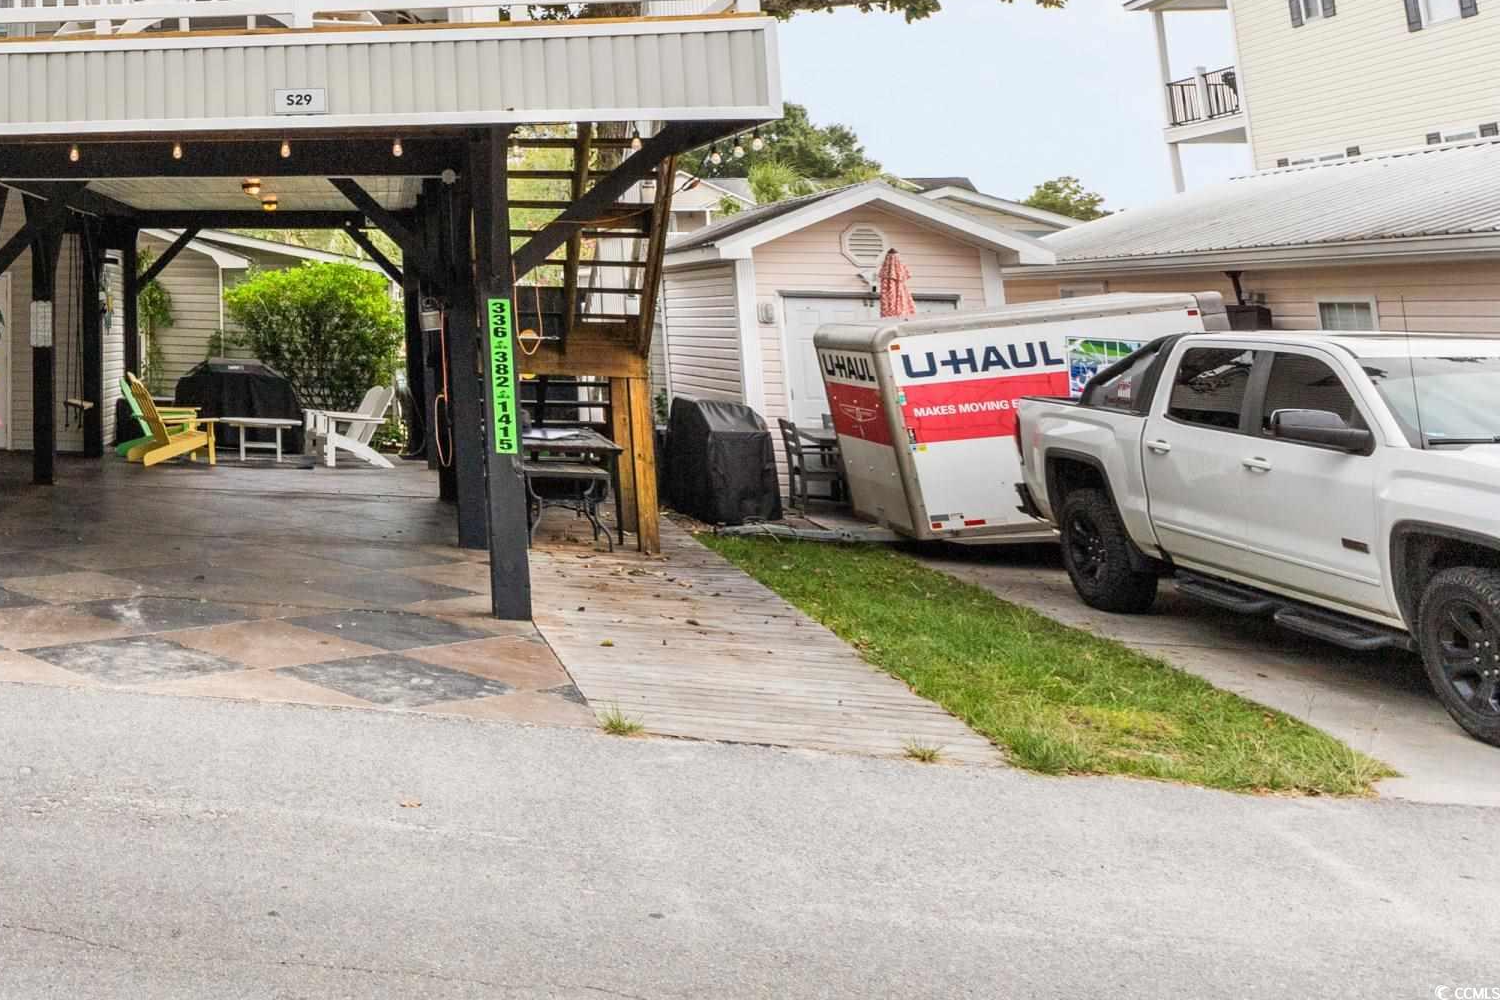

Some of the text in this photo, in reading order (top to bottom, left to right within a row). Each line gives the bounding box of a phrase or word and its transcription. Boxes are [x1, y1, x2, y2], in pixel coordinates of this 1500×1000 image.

[286, 94, 312, 106] S29
[822, 354, 875, 382] U-HAUL
[901, 341, 1065, 378] U-HAUL
[913, 405, 957, 417] MAKES
[958, 400, 1010, 413] MOVING
